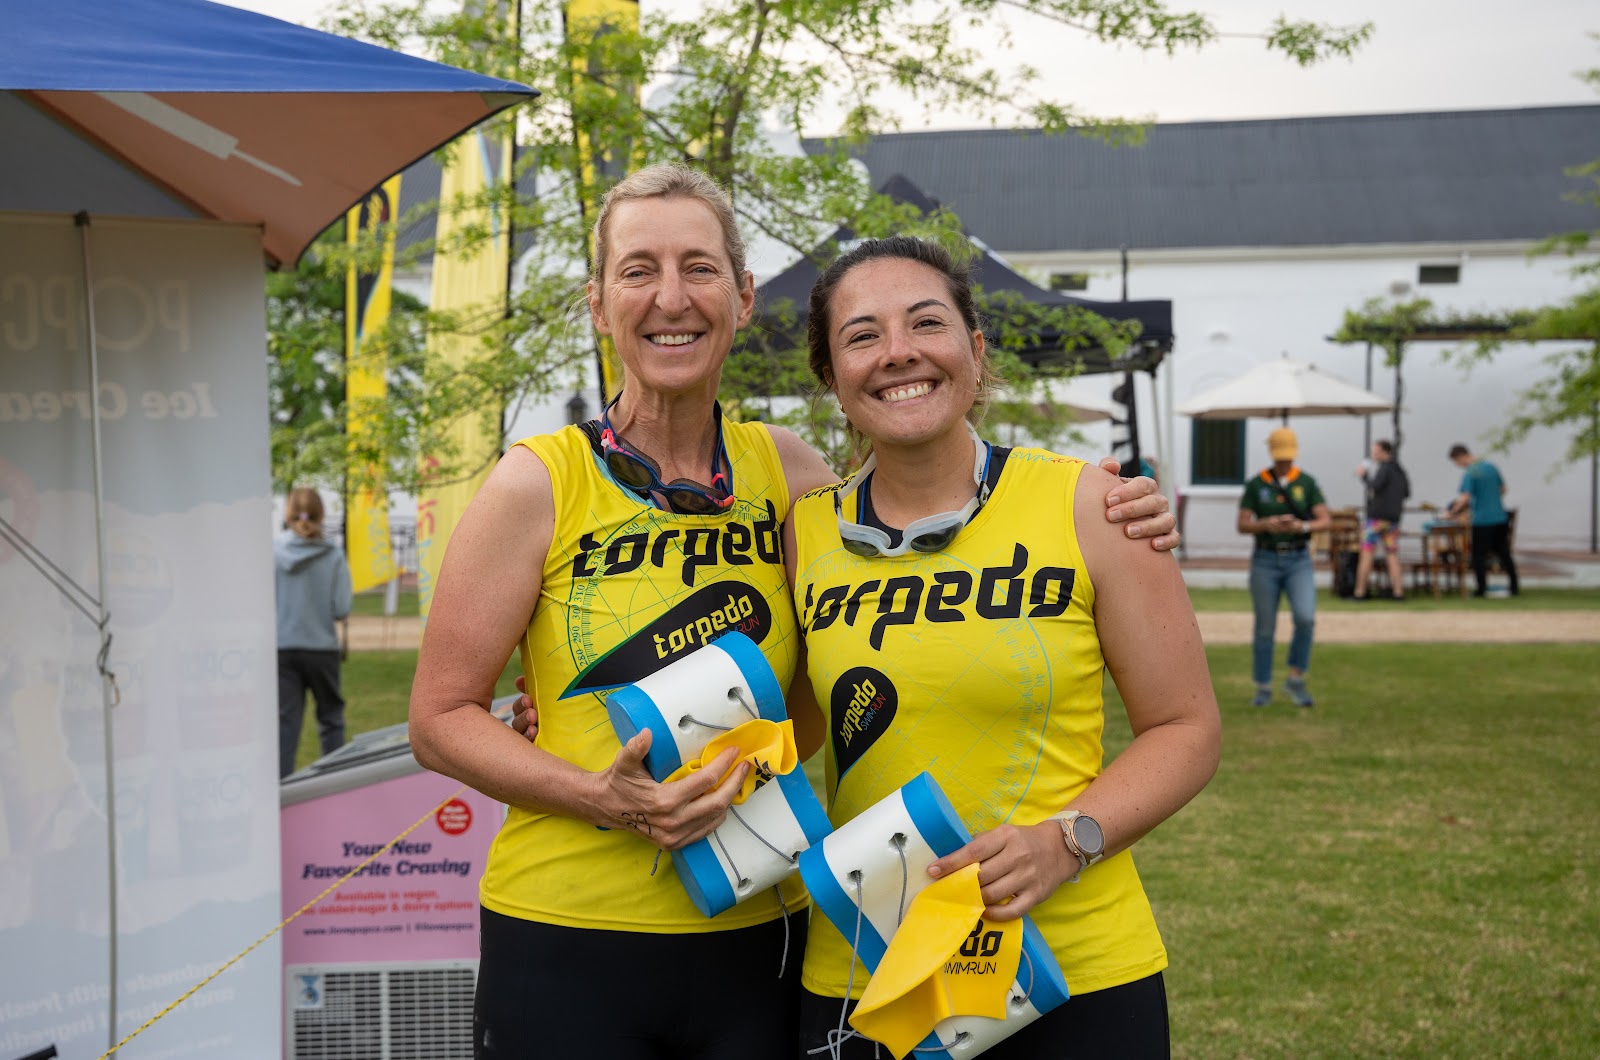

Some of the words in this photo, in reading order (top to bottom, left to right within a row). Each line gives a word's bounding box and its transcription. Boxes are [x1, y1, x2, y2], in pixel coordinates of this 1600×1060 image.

[572, 498, 786, 588] torped
[573, 583, 586, 603] 310
[652, 594, 754, 660] torpedo
[839, 678, 877, 749] torpedo
[860, 692, 887, 731] SWIMRUN
[342, 841, 386, 858] Your
[390, 839, 432, 855] New
[396, 857, 471, 876] Craving
